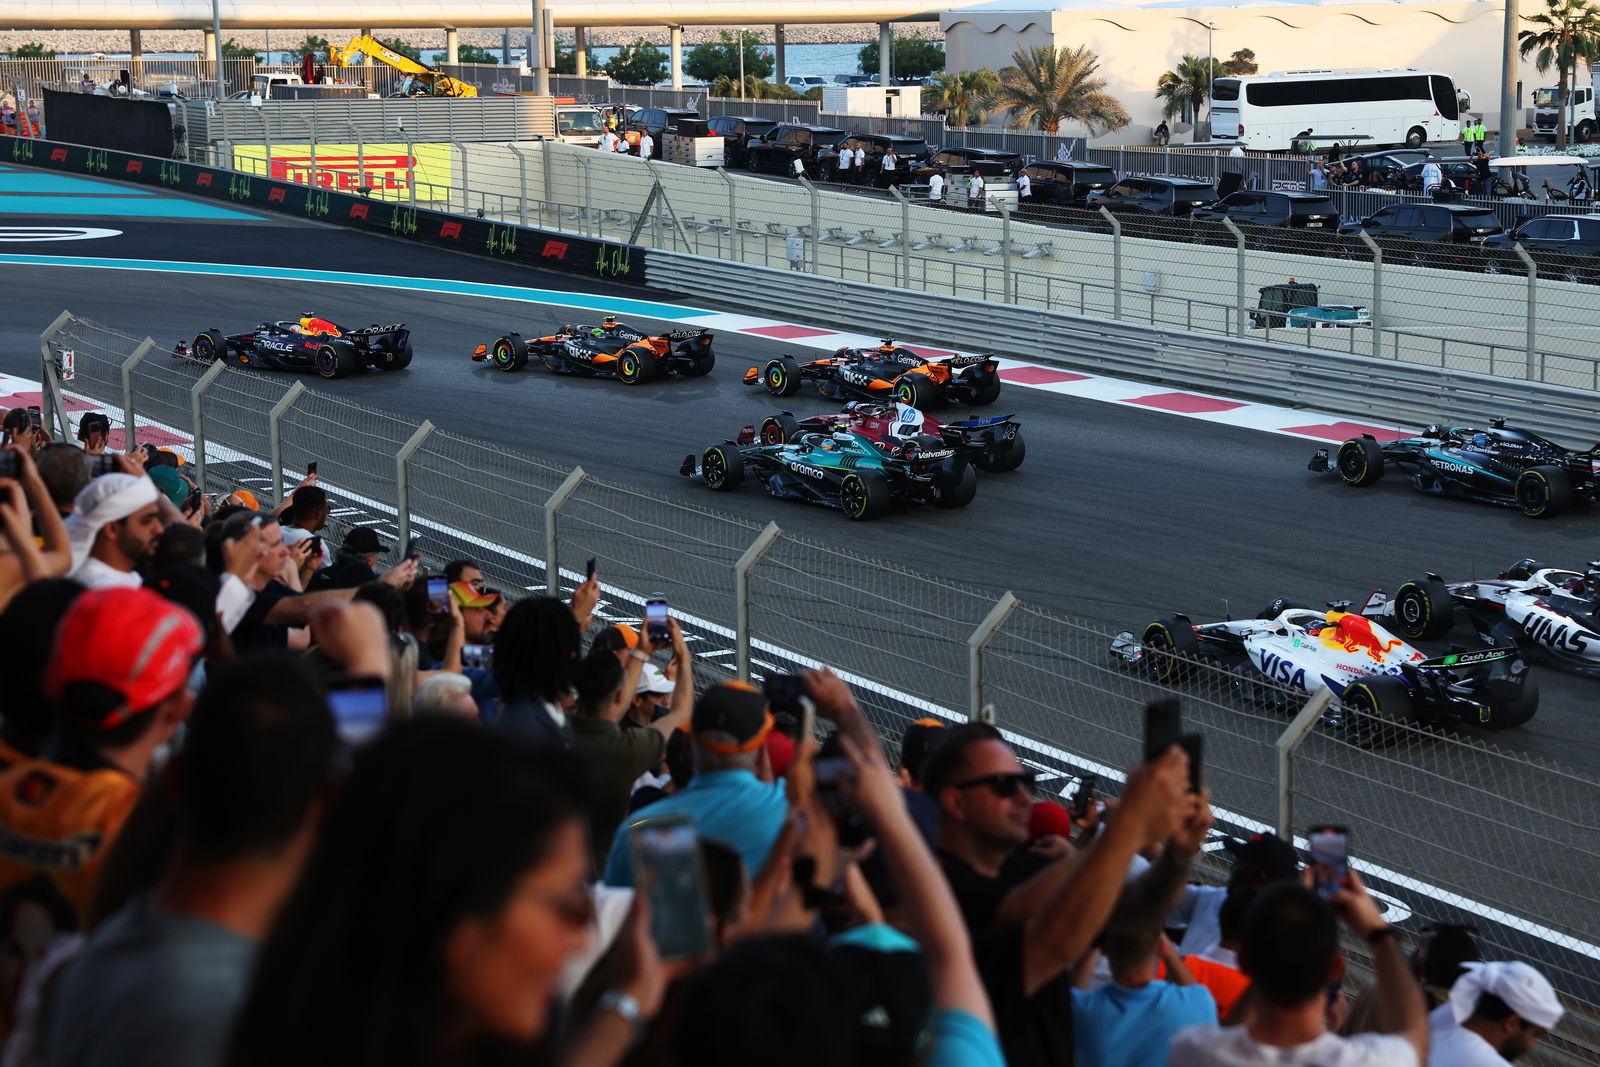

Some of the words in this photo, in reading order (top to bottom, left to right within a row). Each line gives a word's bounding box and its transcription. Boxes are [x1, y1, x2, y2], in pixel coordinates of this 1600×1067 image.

[381, 49, 401, 63] JCB
[271, 155, 417, 192] PIRELLI
[541, 240, 569, 260] F1
[364, 324, 402, 334] ORACLE
[261, 340, 294, 352] ORACLE
[903, 409, 914, 423] hp
[918, 449, 955, 460] Valvoline
[790, 461, 824, 480] aramco
[1430, 459, 1474, 475] PETRONAS
[1460, 651, 1485, 663] Cash
[1486, 650, 1506, 659] App
[1260, 648, 1307, 691] VISA
[1336, 663, 1364, 676] HONDA
